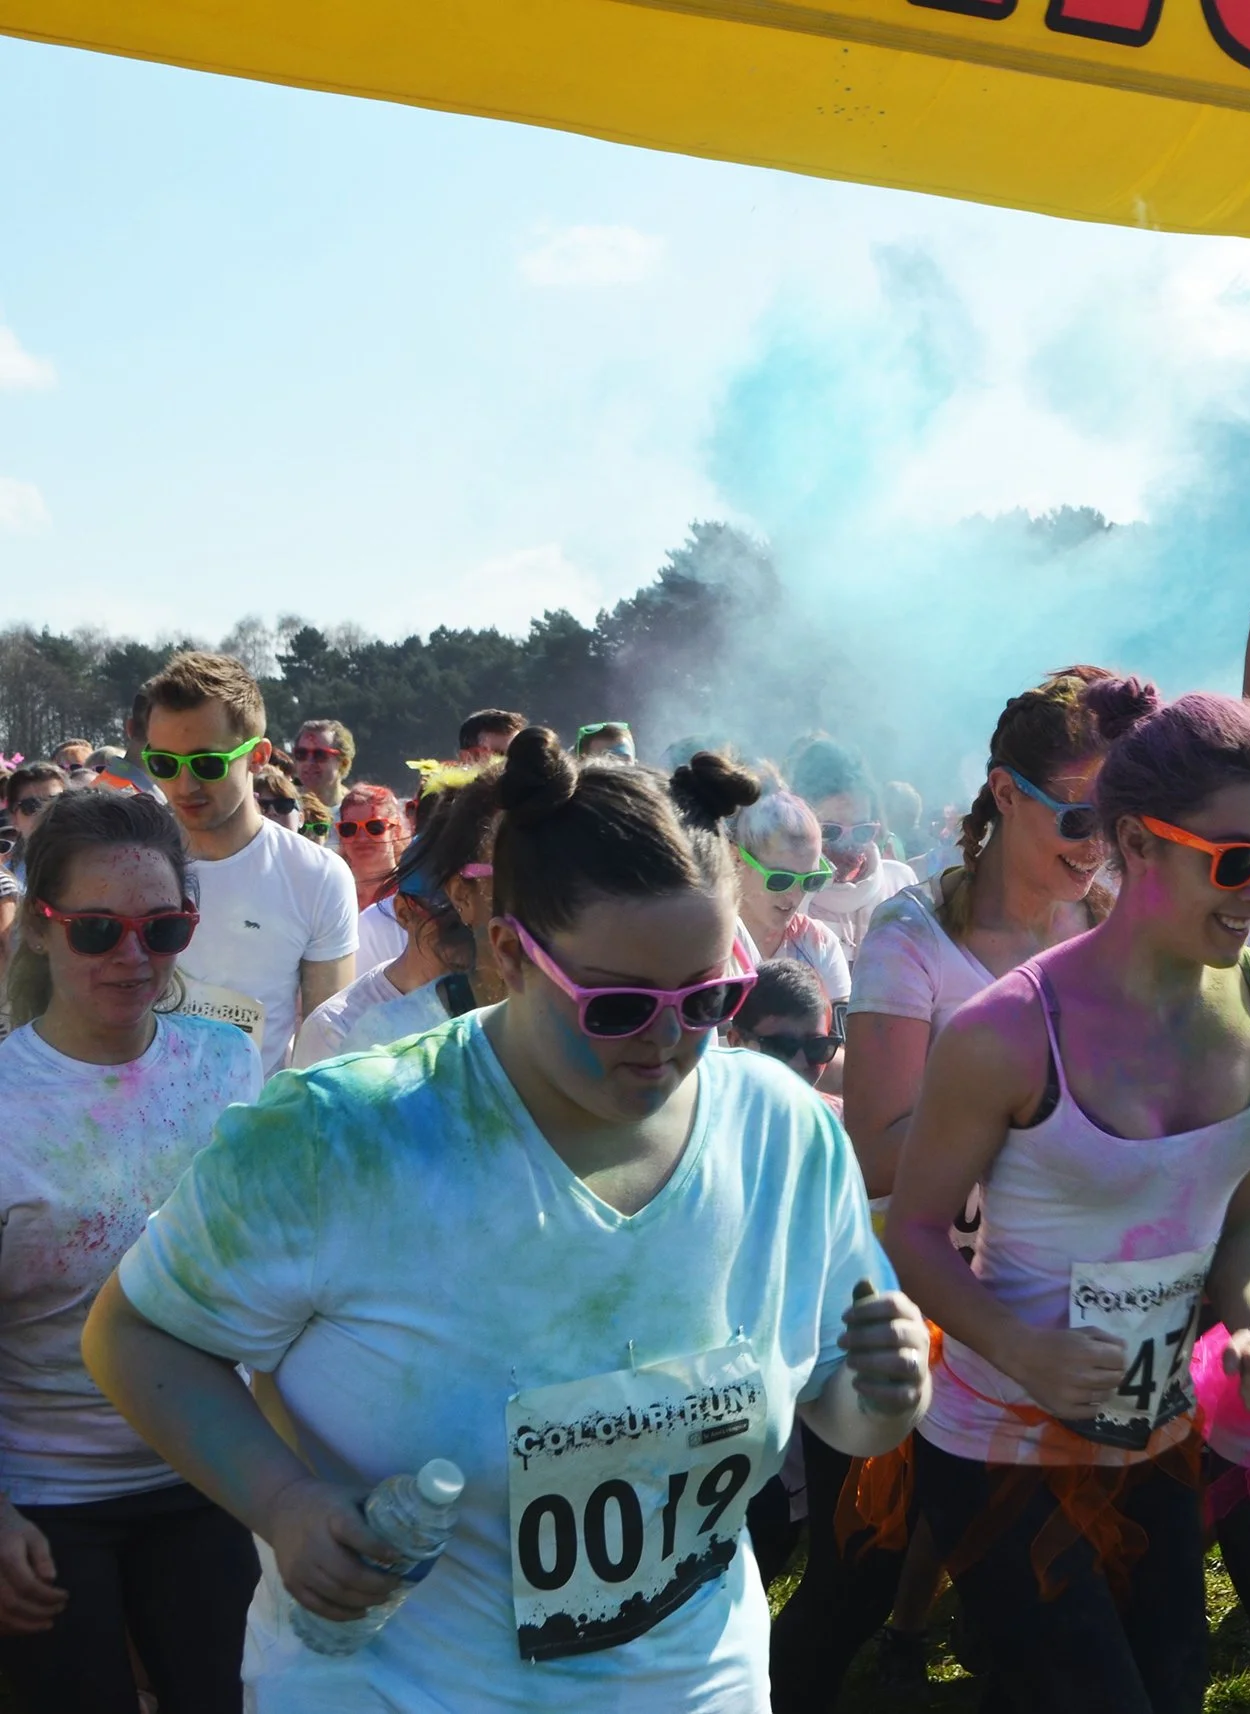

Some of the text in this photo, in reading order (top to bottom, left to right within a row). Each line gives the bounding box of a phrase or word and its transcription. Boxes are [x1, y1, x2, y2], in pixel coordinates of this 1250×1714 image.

[516, 1404, 671, 1456] COLOUR
[682, 1386, 752, 1425] RUN
[518, 1453, 751, 1591] 0019
